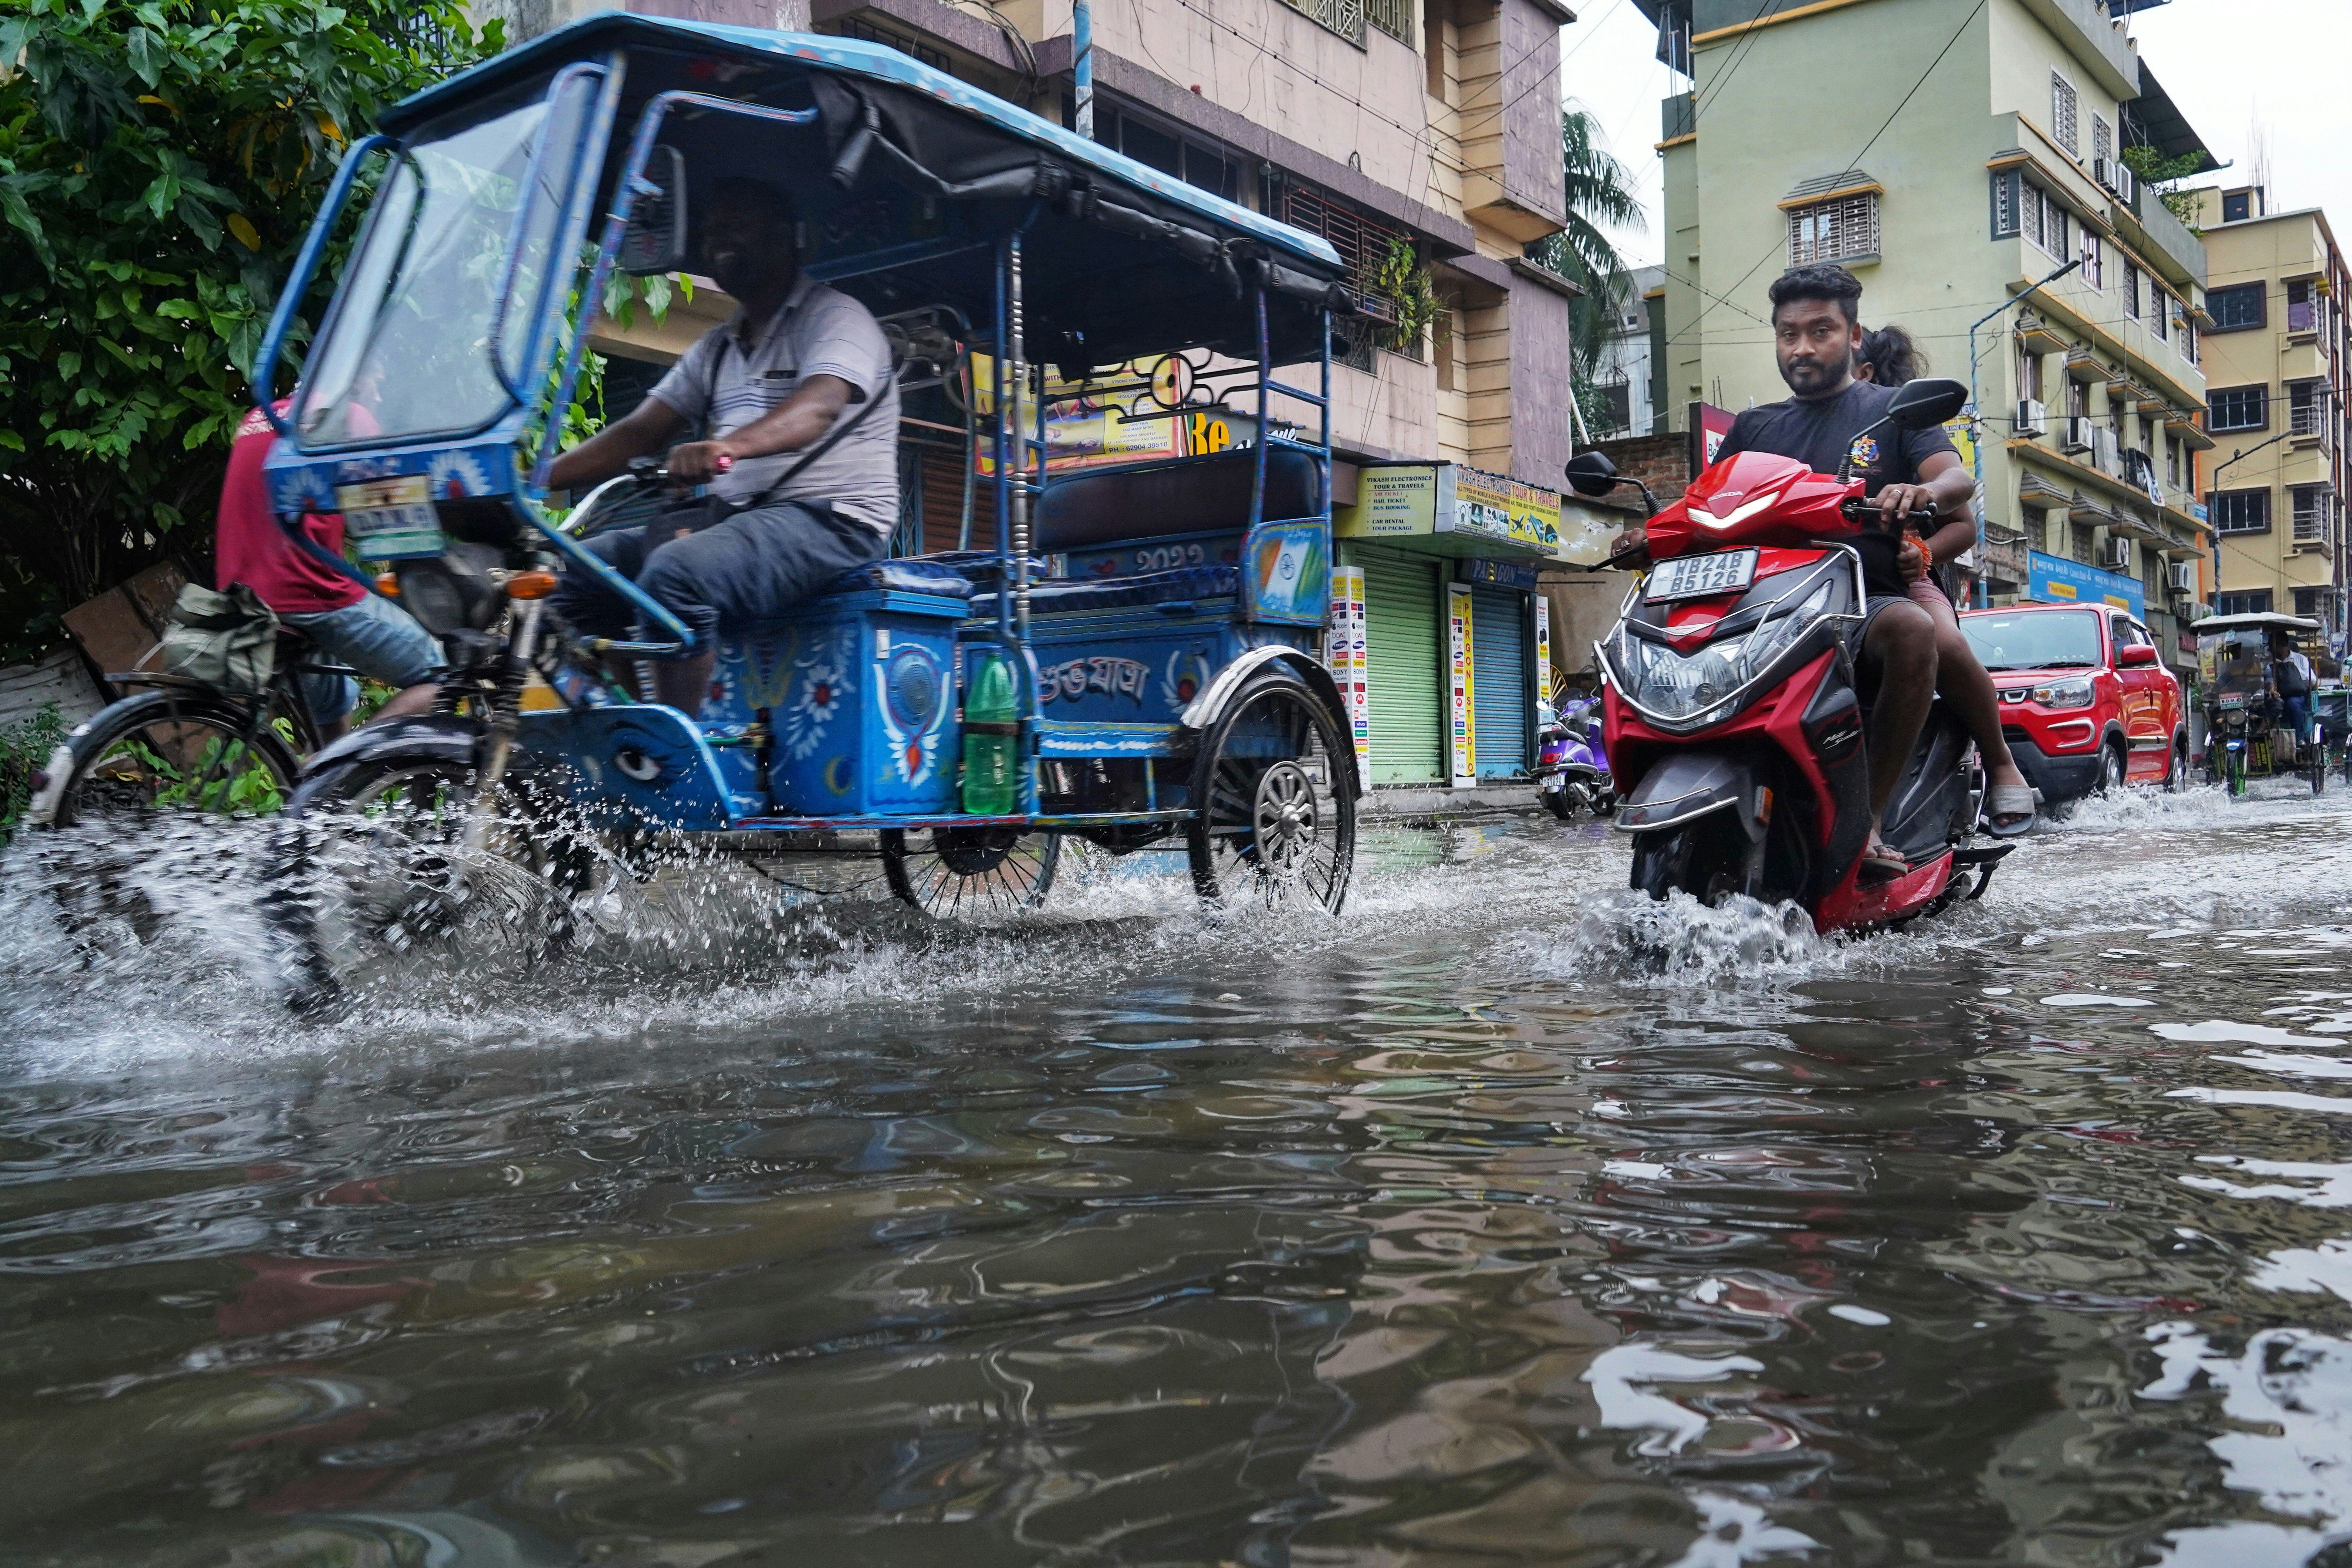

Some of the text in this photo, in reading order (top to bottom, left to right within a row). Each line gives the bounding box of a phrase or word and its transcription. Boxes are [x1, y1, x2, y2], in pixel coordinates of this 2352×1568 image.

[1457, 469, 1511, 496] VIKASH ELECTRONICS
[1477, 497, 1492, 506] AVAILABLE
[1491, 494, 1510, 504] ELECTRONICS
[1512, 484, 1559, 510] TOUR & TRAVELS
[1676, 552, 1743, 577] WB24B
[1670, 569, 1738, 592] B5126
